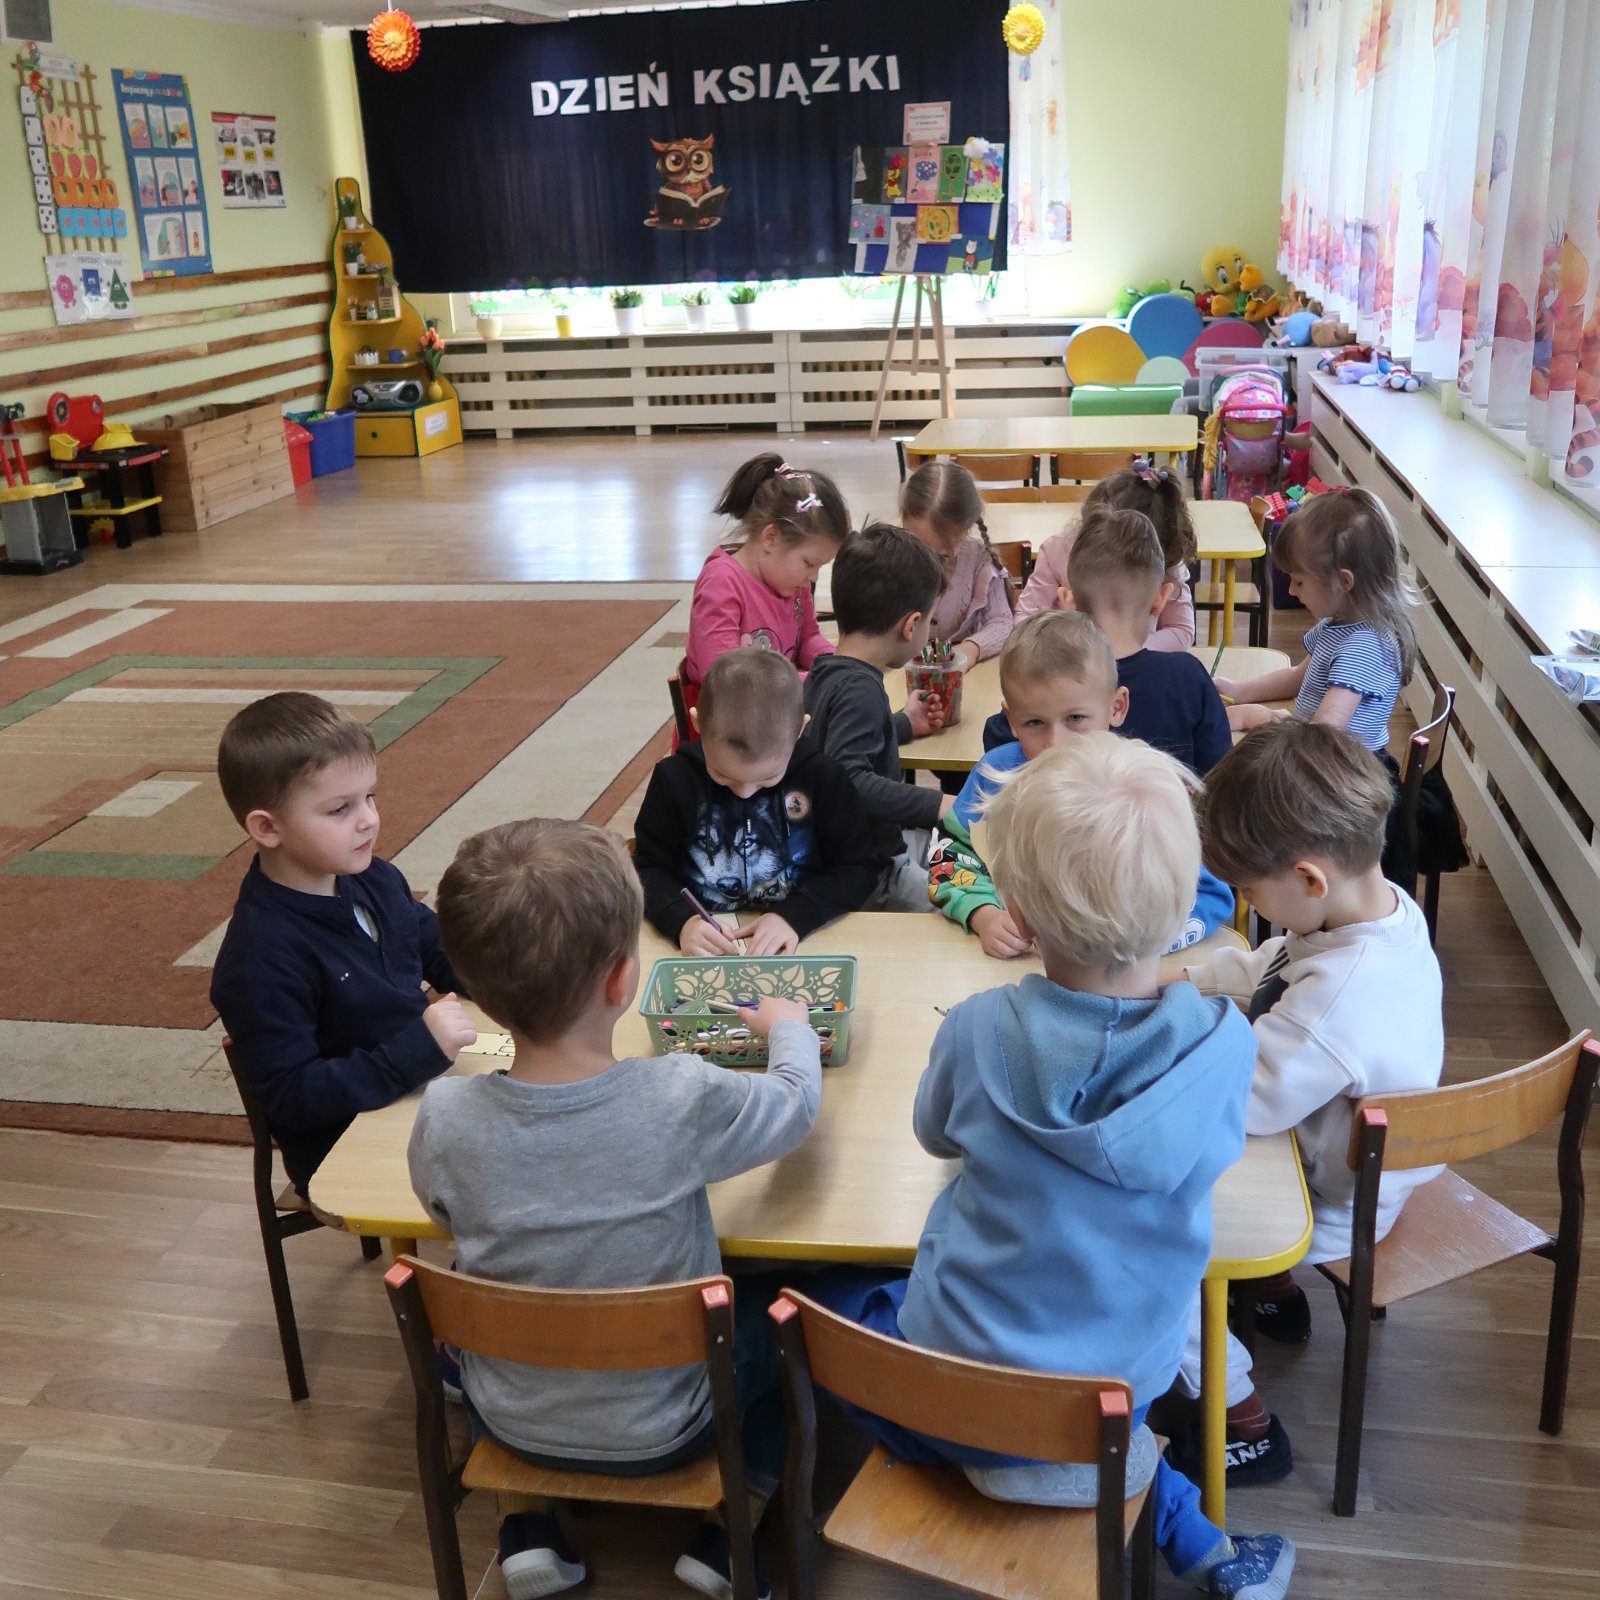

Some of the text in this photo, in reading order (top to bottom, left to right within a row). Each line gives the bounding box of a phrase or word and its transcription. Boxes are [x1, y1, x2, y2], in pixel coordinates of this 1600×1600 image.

[531, 44, 900, 117] DZIEŃ KSIĄŻKI
[1225, 1439, 1271, 1469] ANS
